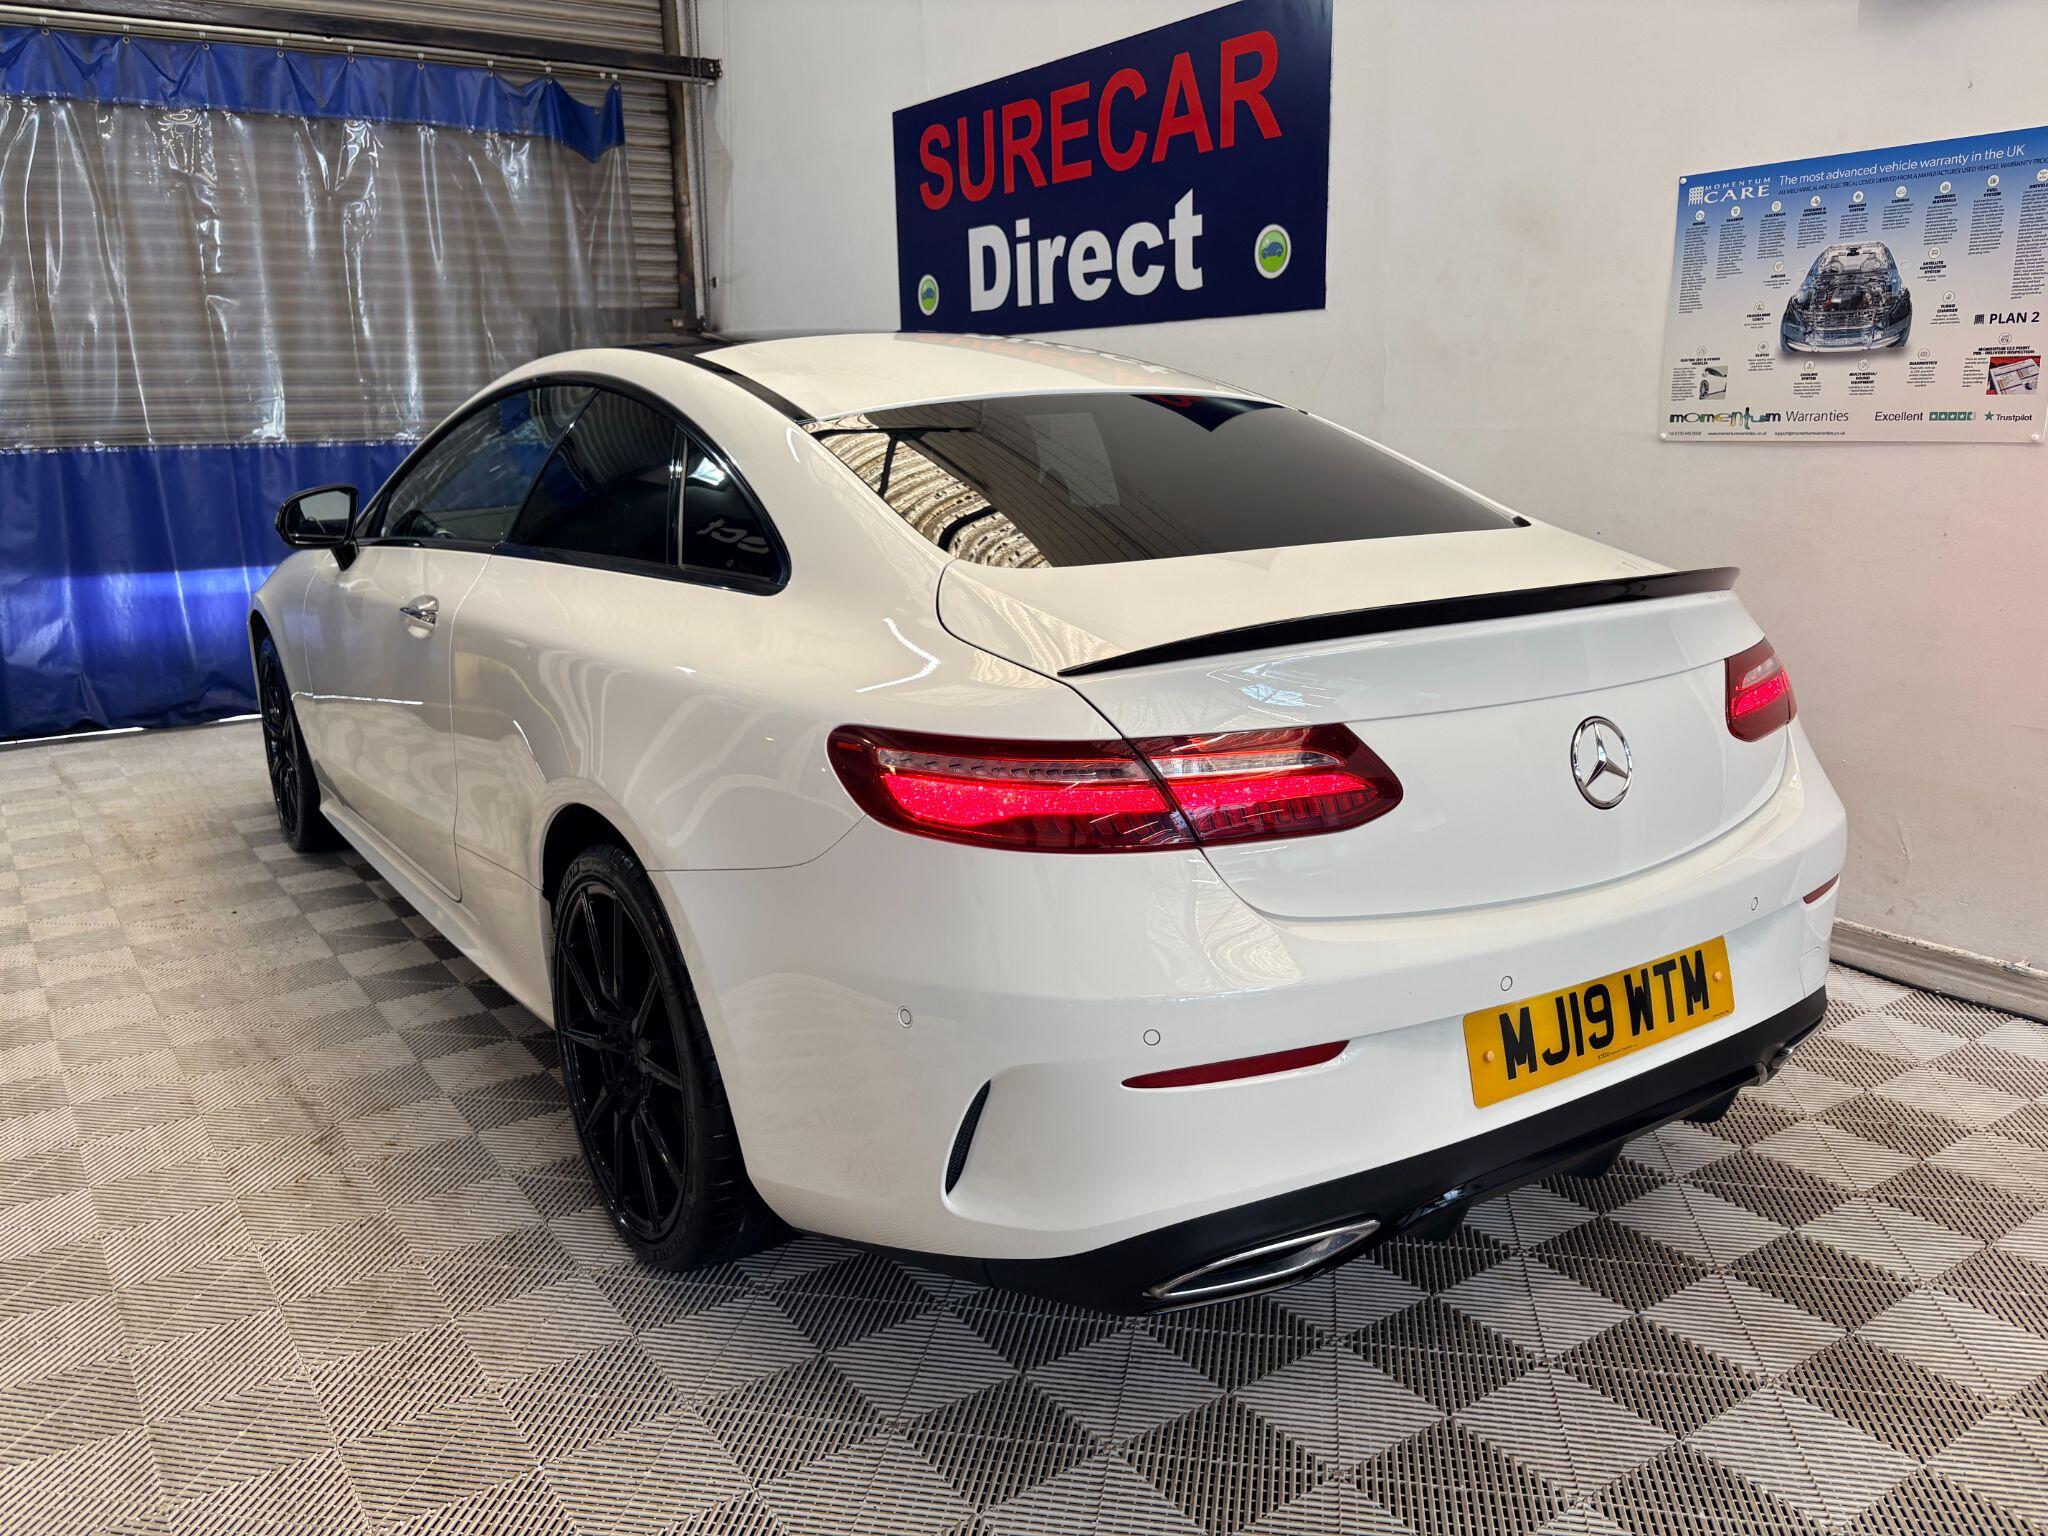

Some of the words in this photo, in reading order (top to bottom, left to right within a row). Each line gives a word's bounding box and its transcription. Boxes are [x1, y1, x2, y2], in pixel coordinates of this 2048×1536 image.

[919, 30, 1283, 210] SURECAR
[1779, 175, 1797, 186] The
[1799, 172, 1824, 183] most
[1826, 164, 1877, 180] advanced
[1879, 159, 1917, 173] vehicle
[1919, 152, 1969, 168] warranty
[1971, 151, 1982, 162] in
[1984, 148, 2003, 160] the
[2007, 144, 2026, 158] UK
[1704, 185, 1770, 204] CARE
[1705, 177, 1771, 191] MOMENTUM
[967, 188, 1204, 313] Direct
[1988, 312, 2027, 325] PLAN
[2030, 311, 2040, 323] 2
[1669, 406, 1781, 430] momentum
[1785, 410, 1849, 422] Warranties
[1874, 411, 1924, 421] Excellent
[1996, 413, 2032, 422] Trustpilot
[1499, 984, 1614, 1080] MJ19
[1623, 949, 1710, 1036] WTM
